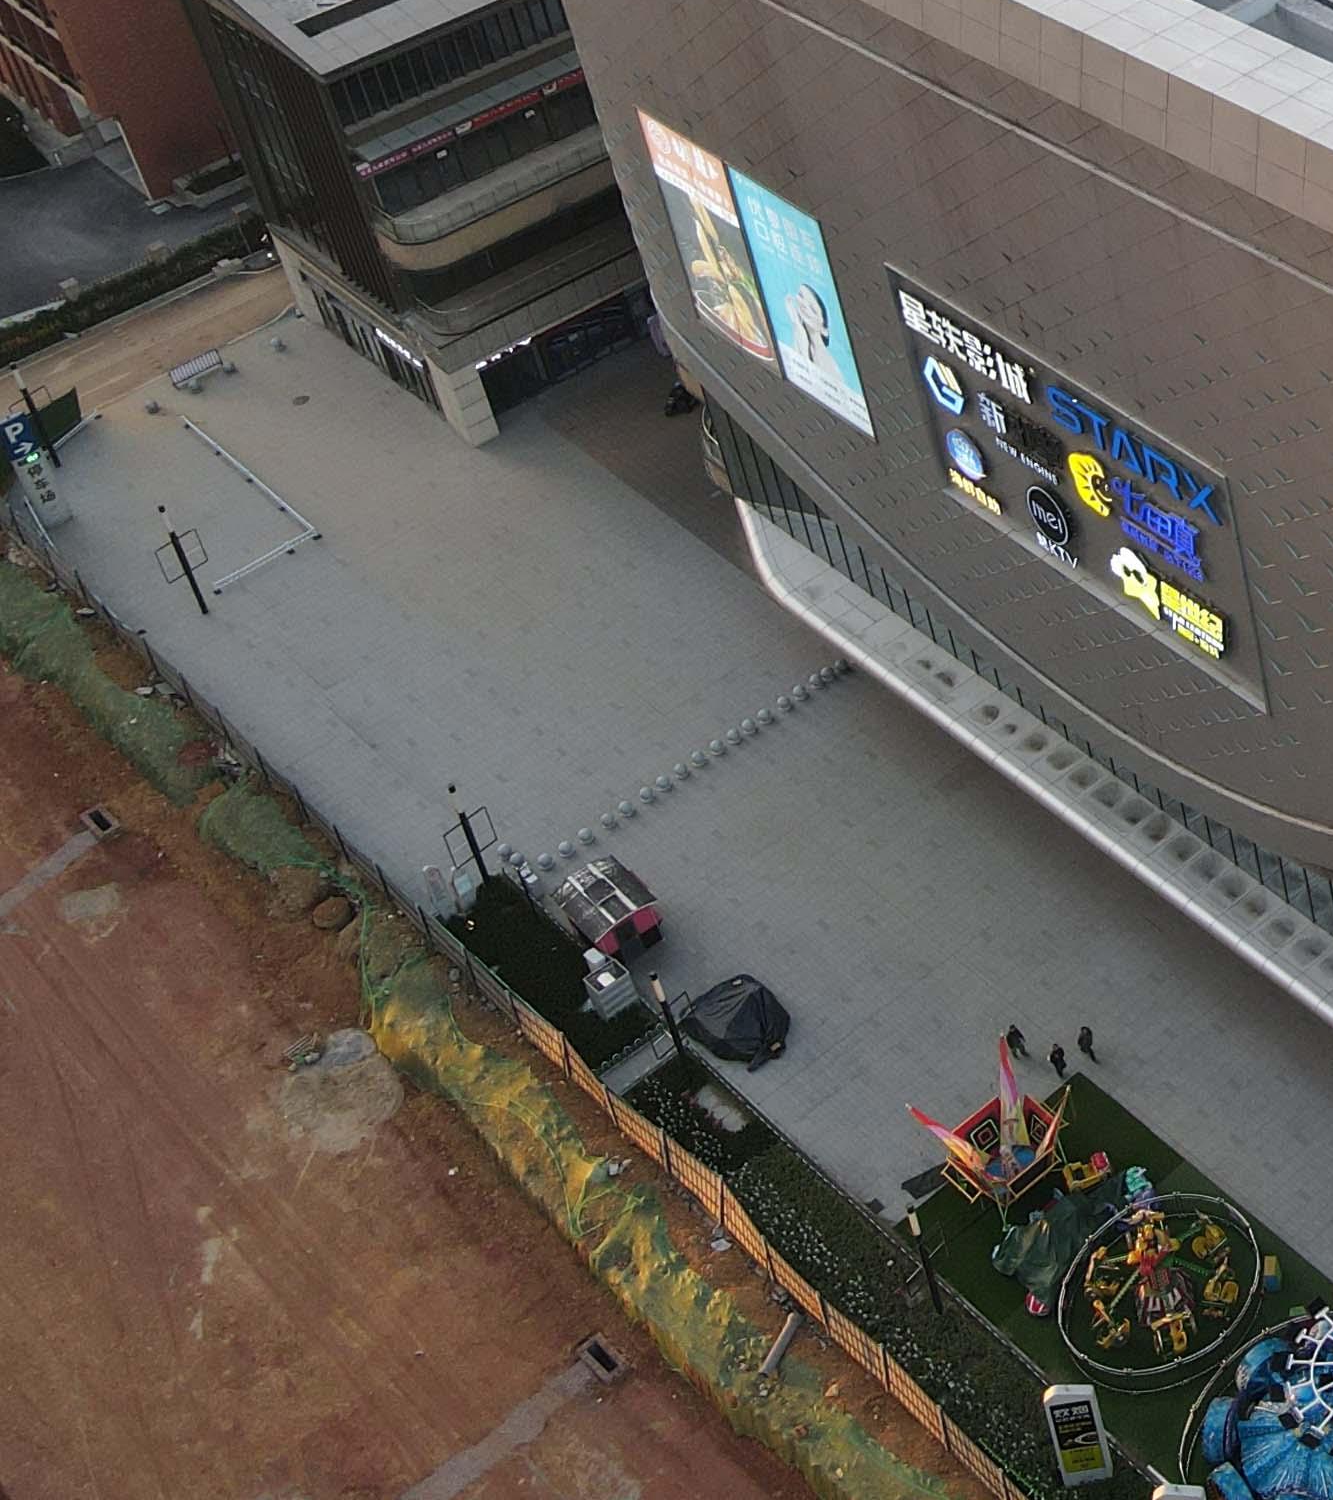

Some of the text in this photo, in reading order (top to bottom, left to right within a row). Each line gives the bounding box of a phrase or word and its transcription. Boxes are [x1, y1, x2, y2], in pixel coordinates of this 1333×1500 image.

[898, 289, 1033, 405] 星轶影城
[4, 422, 24, 444] P
[995, 436, 1018, 459] NEW
[1020, 453, 1059, 486] ENGINE
[1046, 384, 1225, 526] STARX
